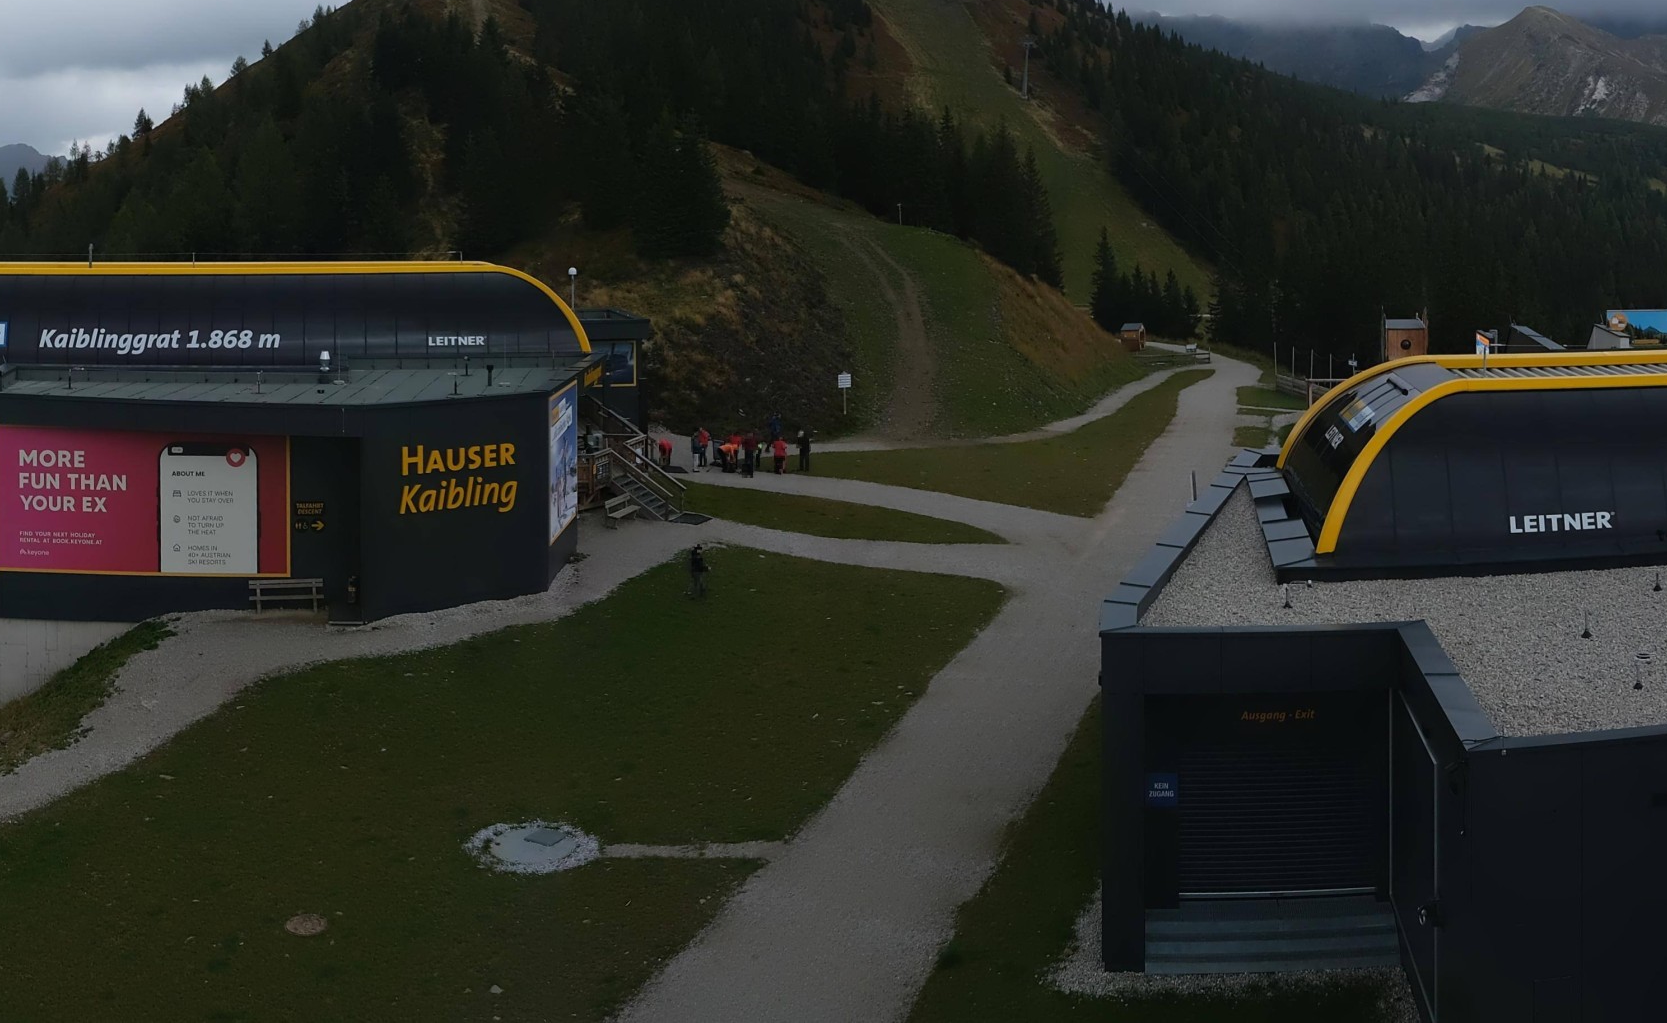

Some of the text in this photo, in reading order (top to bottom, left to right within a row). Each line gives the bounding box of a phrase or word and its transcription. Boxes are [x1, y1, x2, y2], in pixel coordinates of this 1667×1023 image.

[38, 328, 281, 356] Kaiblinggrat 1.868 m
[428, 335, 486, 346] LEITNER
[18, 449, 86, 468] MORE
[401, 443, 516, 476] HAUSER
[18, 473, 127, 491] FUN THAN
[19, 495, 108, 513] YOUR EX
[400, 477, 518, 515] Kaibling
[1509, 512, 1613, 533] LEITNER
[1240, 711, 1286, 723] Ausgang
[1294, 709, 1315, 719] Exit
[1154, 782, 1169, 790] KEIN
